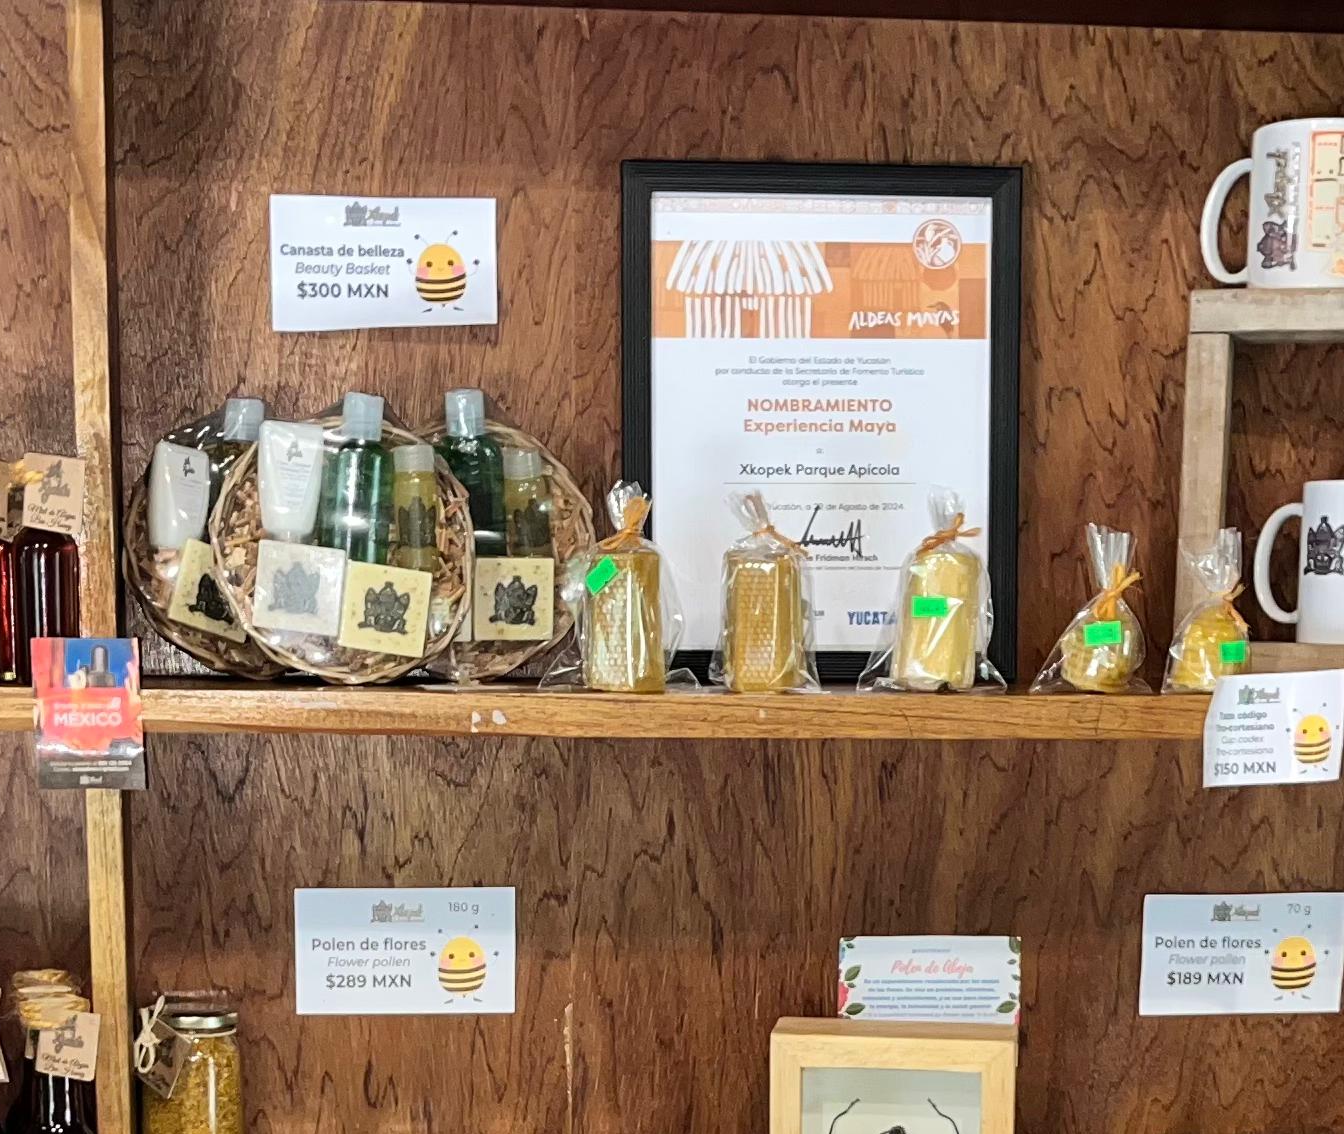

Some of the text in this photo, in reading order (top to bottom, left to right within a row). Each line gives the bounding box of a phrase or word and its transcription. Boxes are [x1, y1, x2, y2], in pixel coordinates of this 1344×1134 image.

[280, 244, 405, 258] Canasta de belleza
[295, 262, 391, 277] Beauty Basket
[297, 281, 389, 300] $300 MXN
[848, 310, 960, 331] ALDEAS MAYAS
[747, 398, 893, 413] NOMBRAMIENTO
[743, 418, 896, 436] Experiencia Maya
[739, 463, 900, 478] Xkopek Parque Apícola
[838, 503, 867, 513] Agosto
[1214, 761, 1277, 777] $150 MXN
[471, 903, 480, 915] g
[1287, 904, 1312, 916] 70 g
[311, 937, 427, 951] Polen de flores
[1155, 936, 1262, 949] Polen de flores
[327, 956, 411, 969] Flower pollen
[1168, 953, 1246, 967] Flower pollen
[326, 973, 412, 990] $289 MXN
[1166, 971, 1244, 986] $189 MXN
